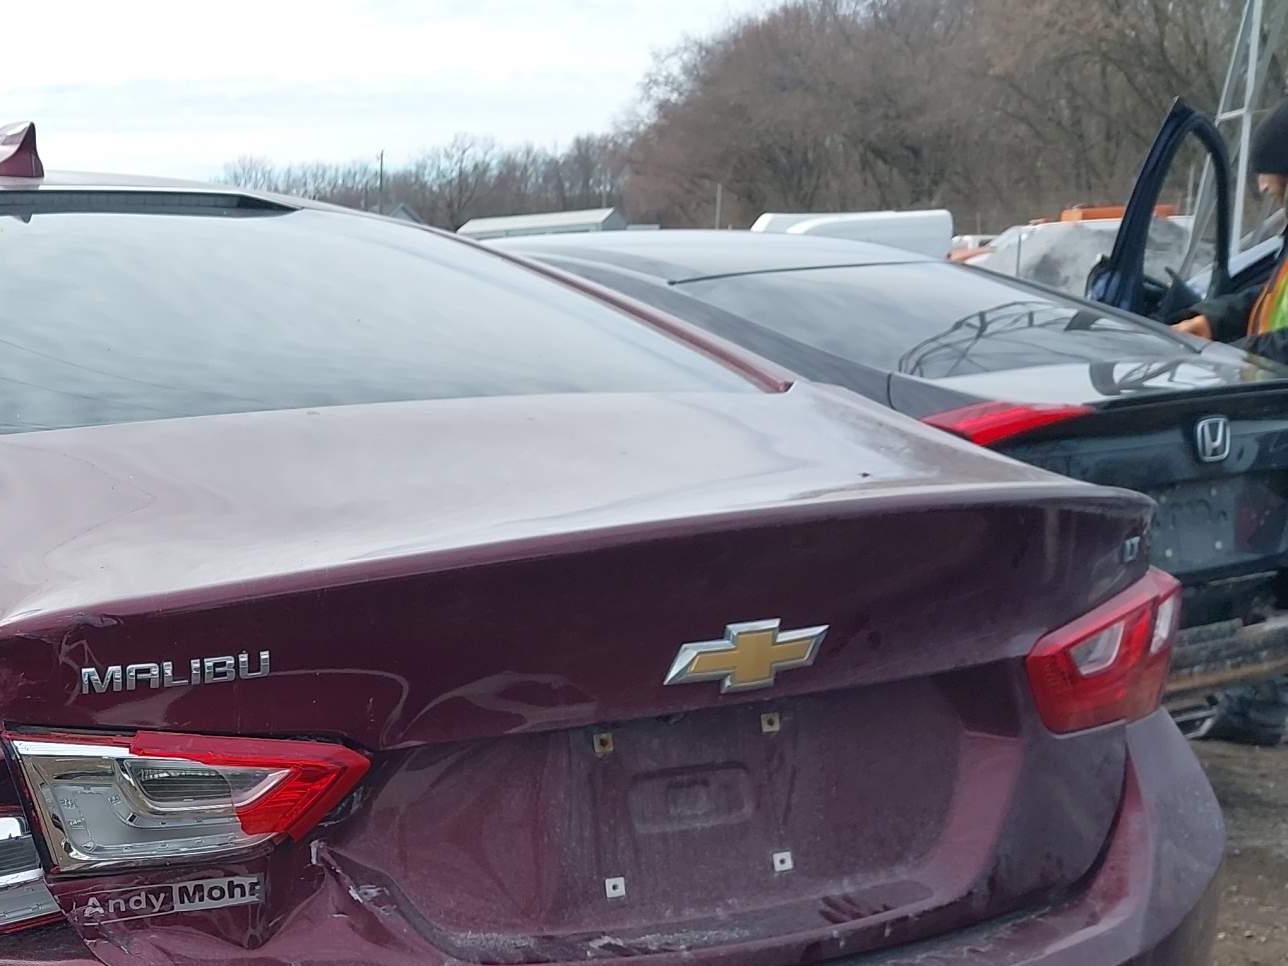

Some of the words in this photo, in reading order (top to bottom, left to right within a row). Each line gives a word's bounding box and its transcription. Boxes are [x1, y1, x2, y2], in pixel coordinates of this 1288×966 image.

[81, 650, 271, 695] MALIBU
[83, 891, 166, 919] Andy
[178, 880, 261, 905] Mohr
